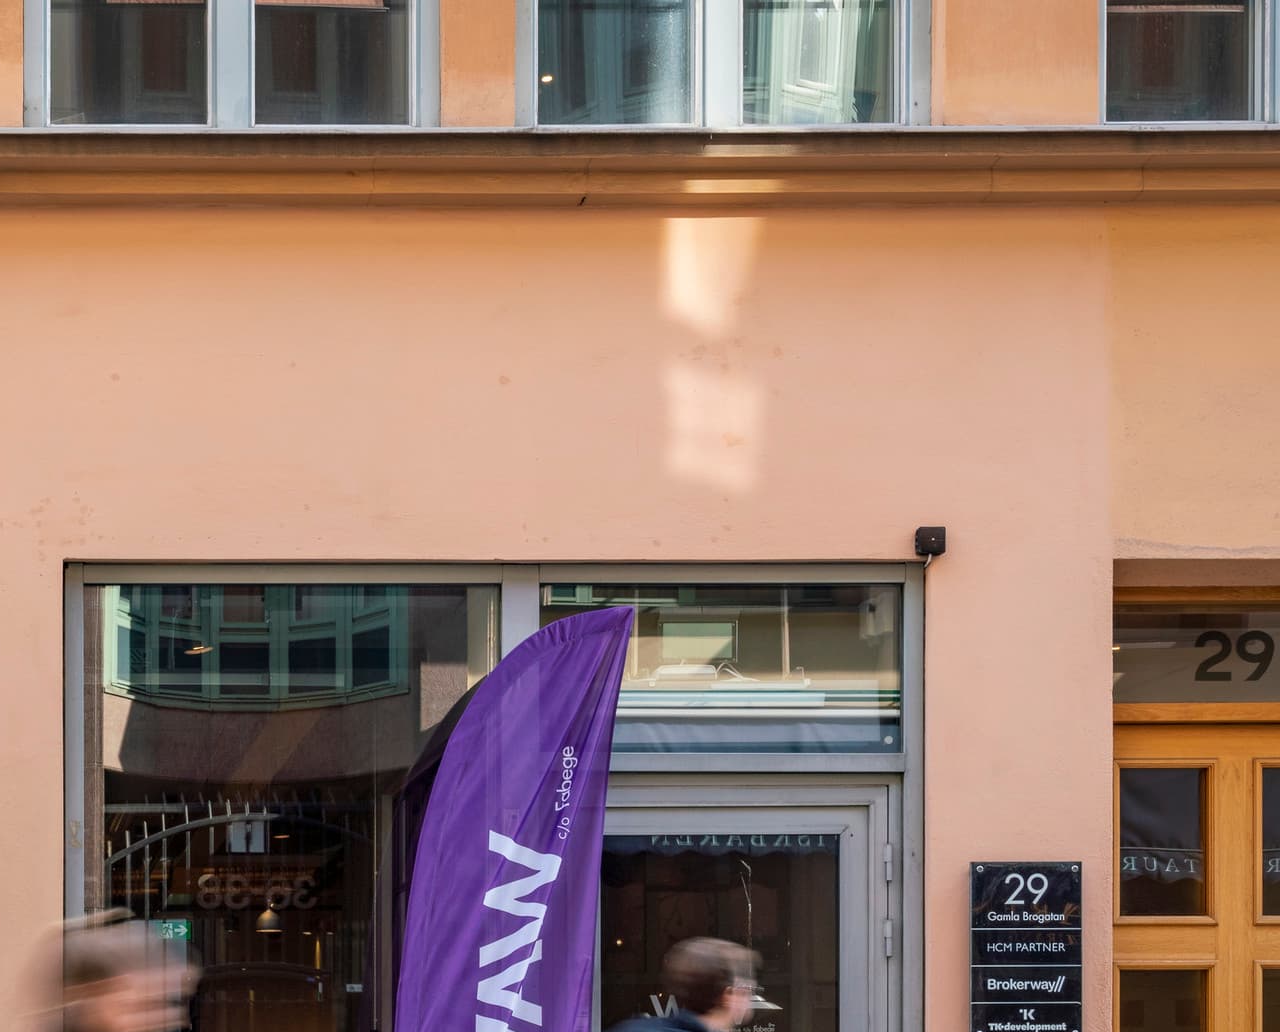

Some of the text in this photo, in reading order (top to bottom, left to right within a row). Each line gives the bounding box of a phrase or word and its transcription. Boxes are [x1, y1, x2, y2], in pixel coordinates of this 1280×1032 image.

[1194, 630, 1275, 681] 29
[554, 746, 578, 840] c/o Fabege
[1004, 873, 1048, 904] 29
[987, 911, 1065, 923] Gamla Brogatan
[987, 943, 1066, 952] HCM PARTNER
